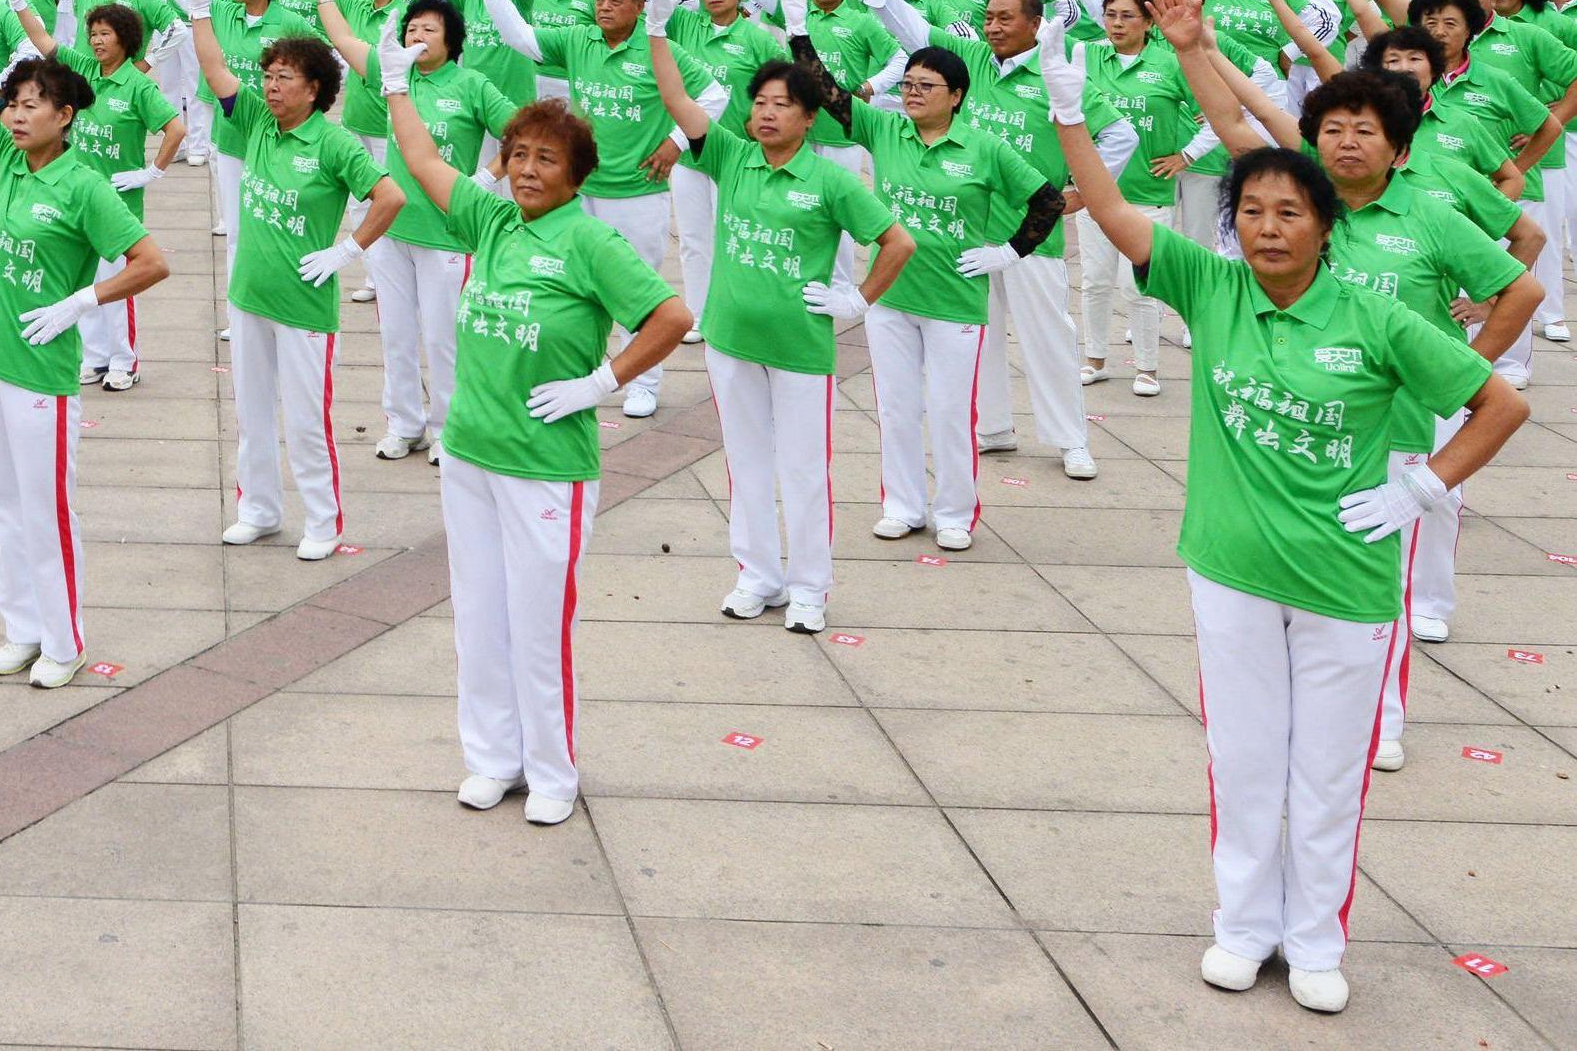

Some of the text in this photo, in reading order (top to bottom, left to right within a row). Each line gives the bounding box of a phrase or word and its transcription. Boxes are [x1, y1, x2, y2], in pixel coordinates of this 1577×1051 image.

[574, 77, 634, 103] 祝福祖国
[576, 97, 642, 123] 舞出文明
[242, 192, 306, 236] 舞出文明
[882, 177, 958, 215] 祝福祖国
[723, 211, 795, 250] 祝福祖国
[889, 200, 966, 240] 舞出文明
[726, 234, 802, 278] 舞出文明
[457, 300, 540, 352] 舞出文明
[1213, 360, 1345, 431] 祝福祖国
[1220, 401, 1354, 469] 舞出文明
